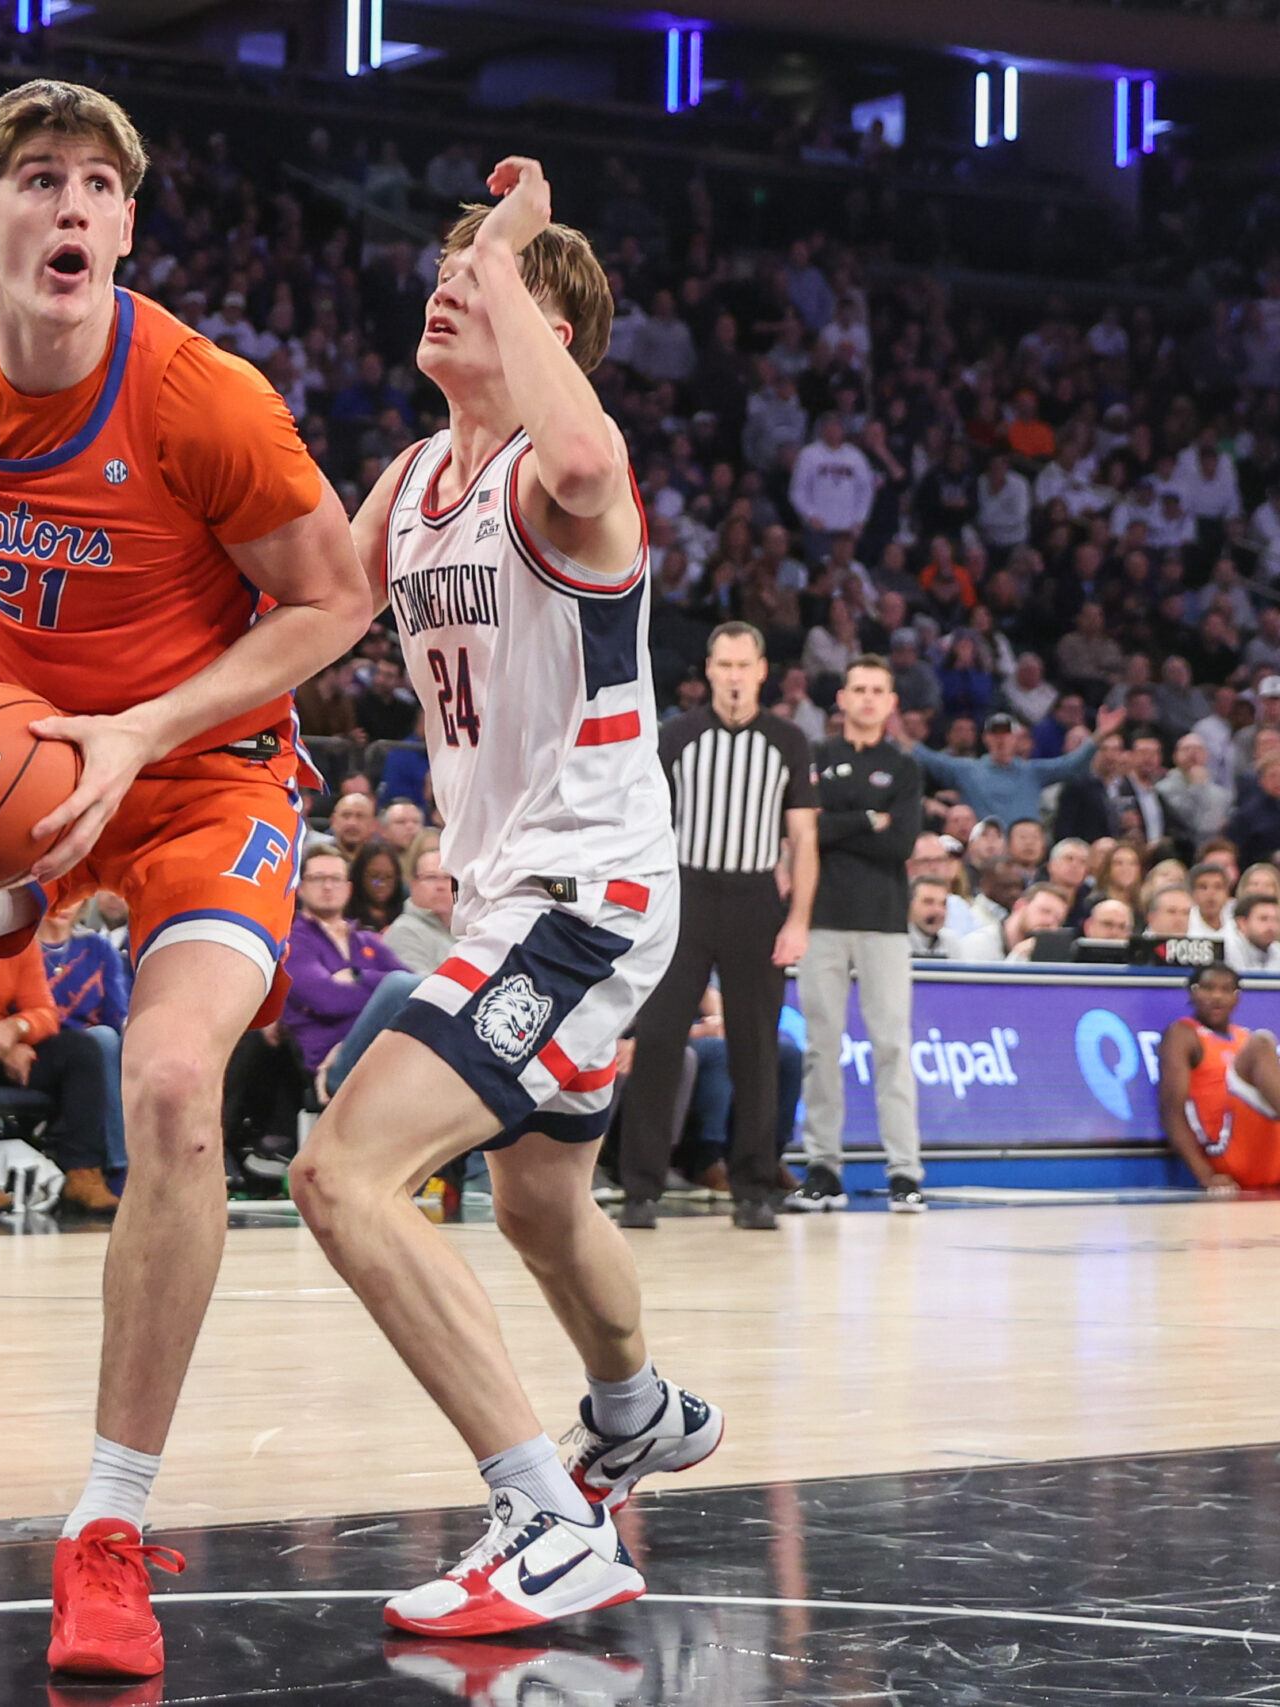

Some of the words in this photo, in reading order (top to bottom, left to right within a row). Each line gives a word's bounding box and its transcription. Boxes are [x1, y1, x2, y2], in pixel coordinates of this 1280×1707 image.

[105, 461, 128, 484] SEC
[477, 523, 500, 538] EAST
[391, 564, 499, 636] CONNECTICUT
[427, 647, 481, 748] 24
[262, 734, 276, 747] 50
[220, 816, 291, 887] F
[1166, 938, 1215, 967] POSS
